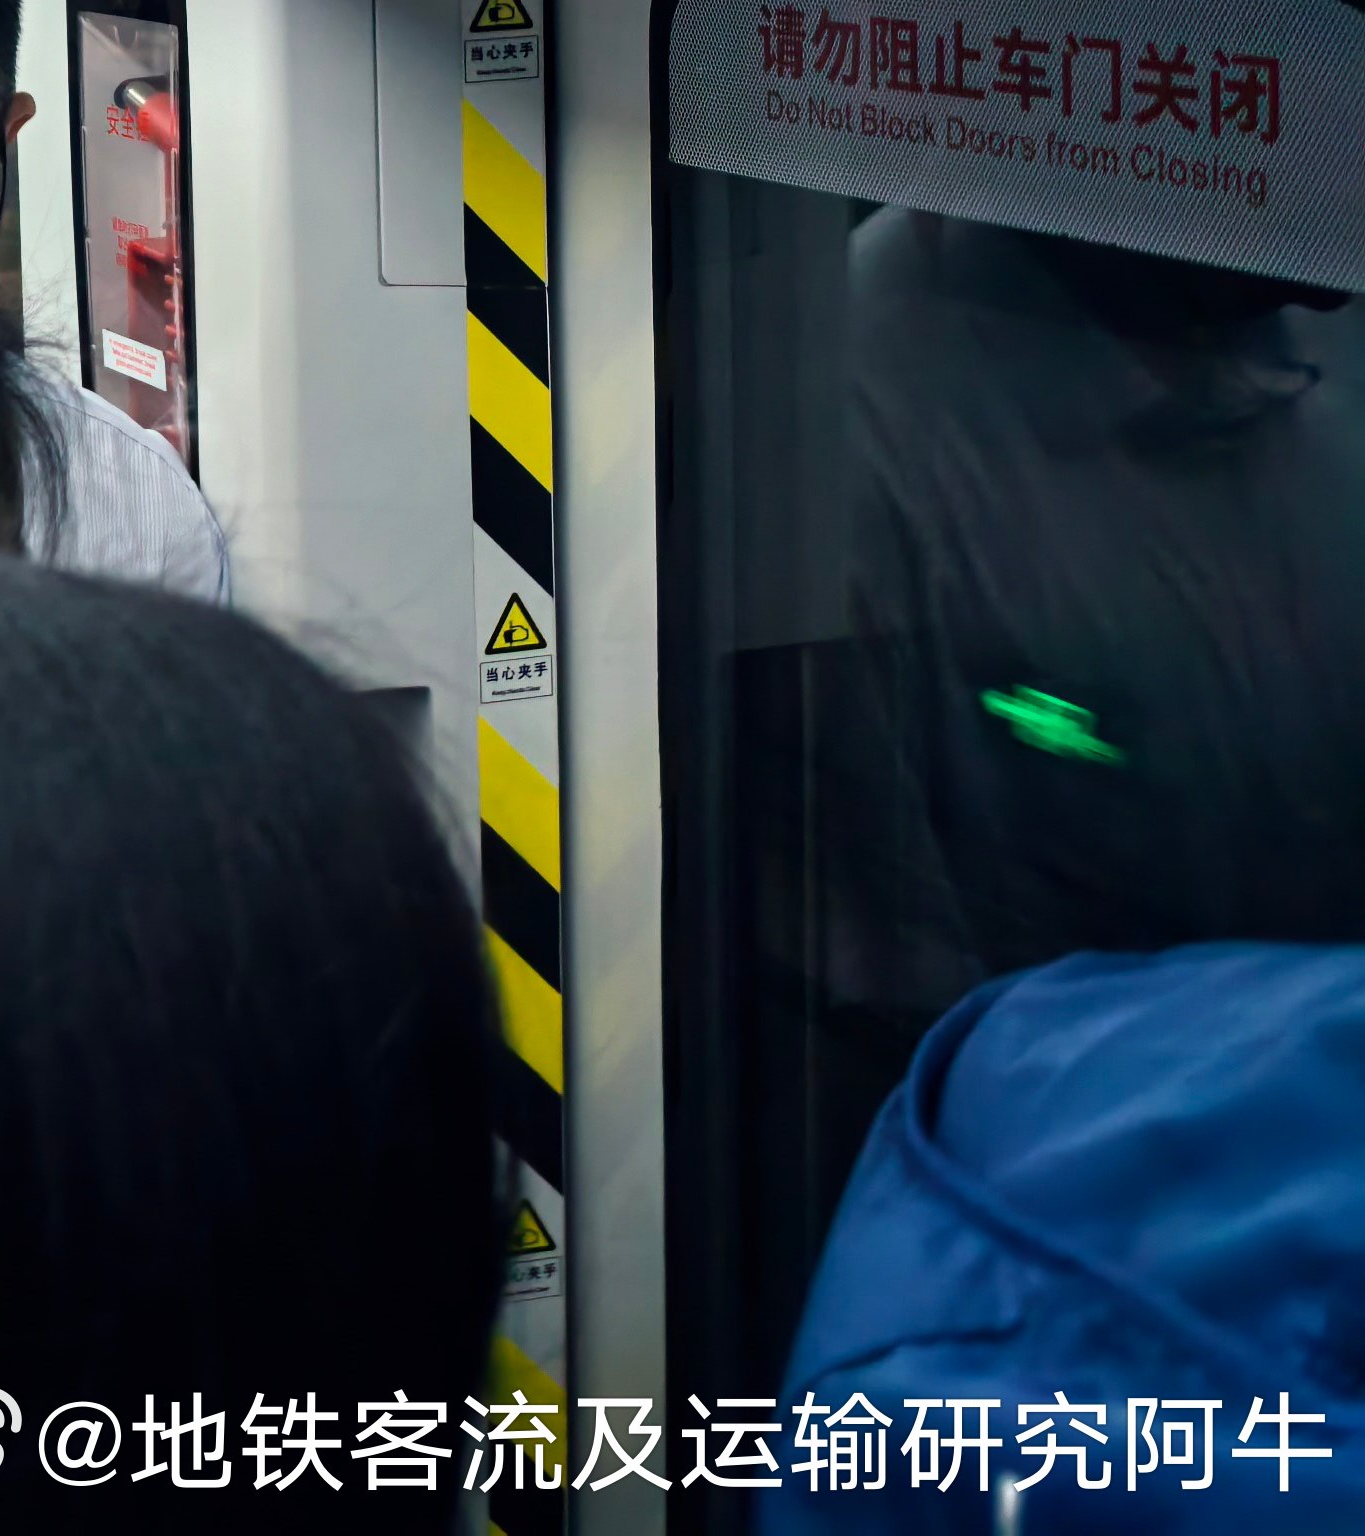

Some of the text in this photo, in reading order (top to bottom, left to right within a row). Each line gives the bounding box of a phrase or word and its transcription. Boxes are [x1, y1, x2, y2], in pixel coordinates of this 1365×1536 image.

[471, 42, 534, 61] 当心夹手
[758, 5, 1281, 146] 请勿阻止车门关闭
[767, 89, 1268, 209] Do Not Block Doors from Closing
[486, 662, 548, 683] 当心夹手
